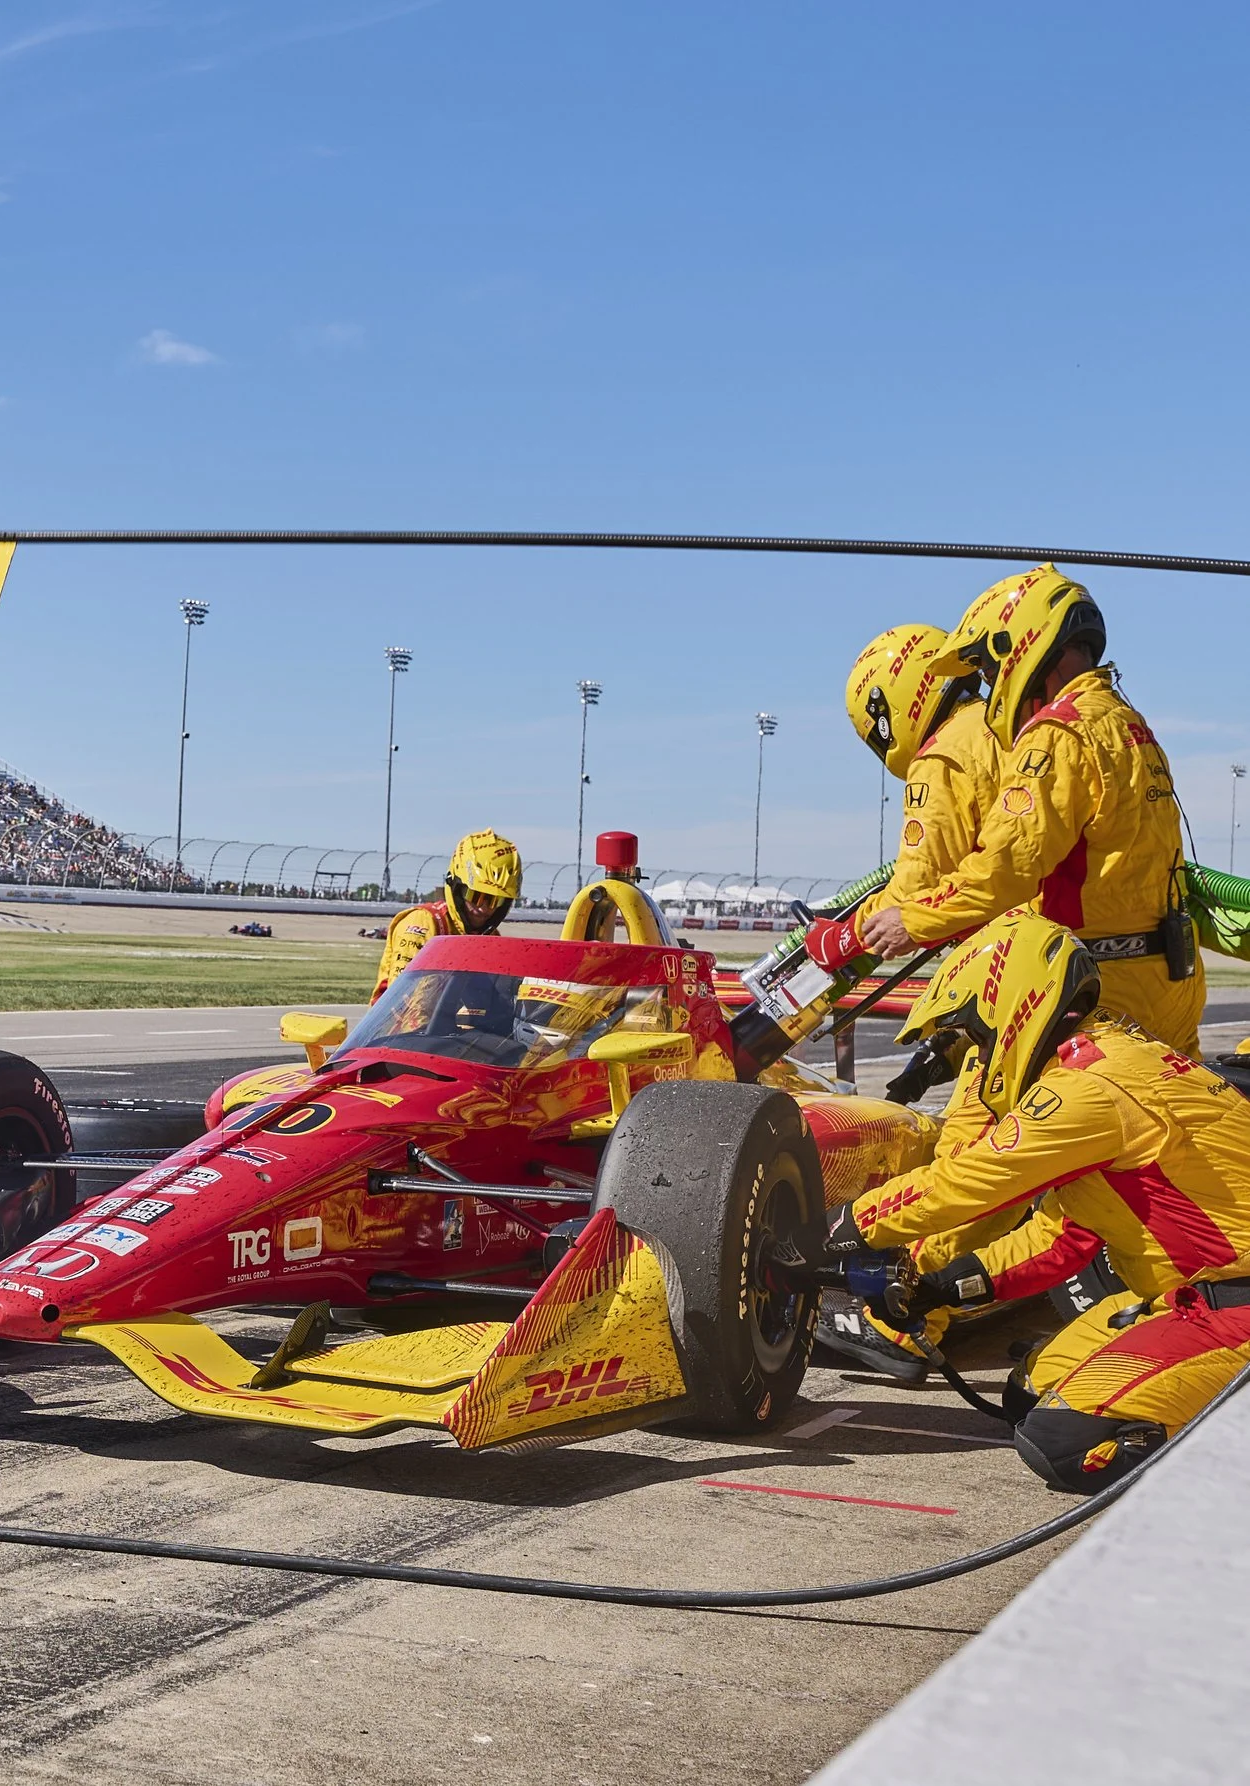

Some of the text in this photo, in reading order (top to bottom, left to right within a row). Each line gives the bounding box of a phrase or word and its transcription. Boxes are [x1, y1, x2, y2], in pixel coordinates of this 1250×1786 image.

[999, 577, 1040, 625] DHL
[889, 634, 925, 677] DHL
[1001, 628, 1042, 681] DHL
[854, 667, 877, 697] DHL
[947, 947, 981, 983] DHL
[981, 939, 1013, 1007] DHL
[528, 987, 571, 1003] DHL
[999, 988, 1048, 1052] DHL
[648, 1047, 684, 1059] DHL
[654, 1062, 687, 1082] OpenAI
[856, 1185, 924, 1231] DHL
[227, 1227, 271, 1269] TRG
[490, 1232, 510, 1241] Roboze
[738, 1163, 765, 1321] Firestone
[237, 1272, 252, 1282] ROYAL
[253, 1269, 271, 1279] GROUP
[282, 1261, 322, 1273] OMOLOGATO
[524, 1356, 634, 1415] DHL
